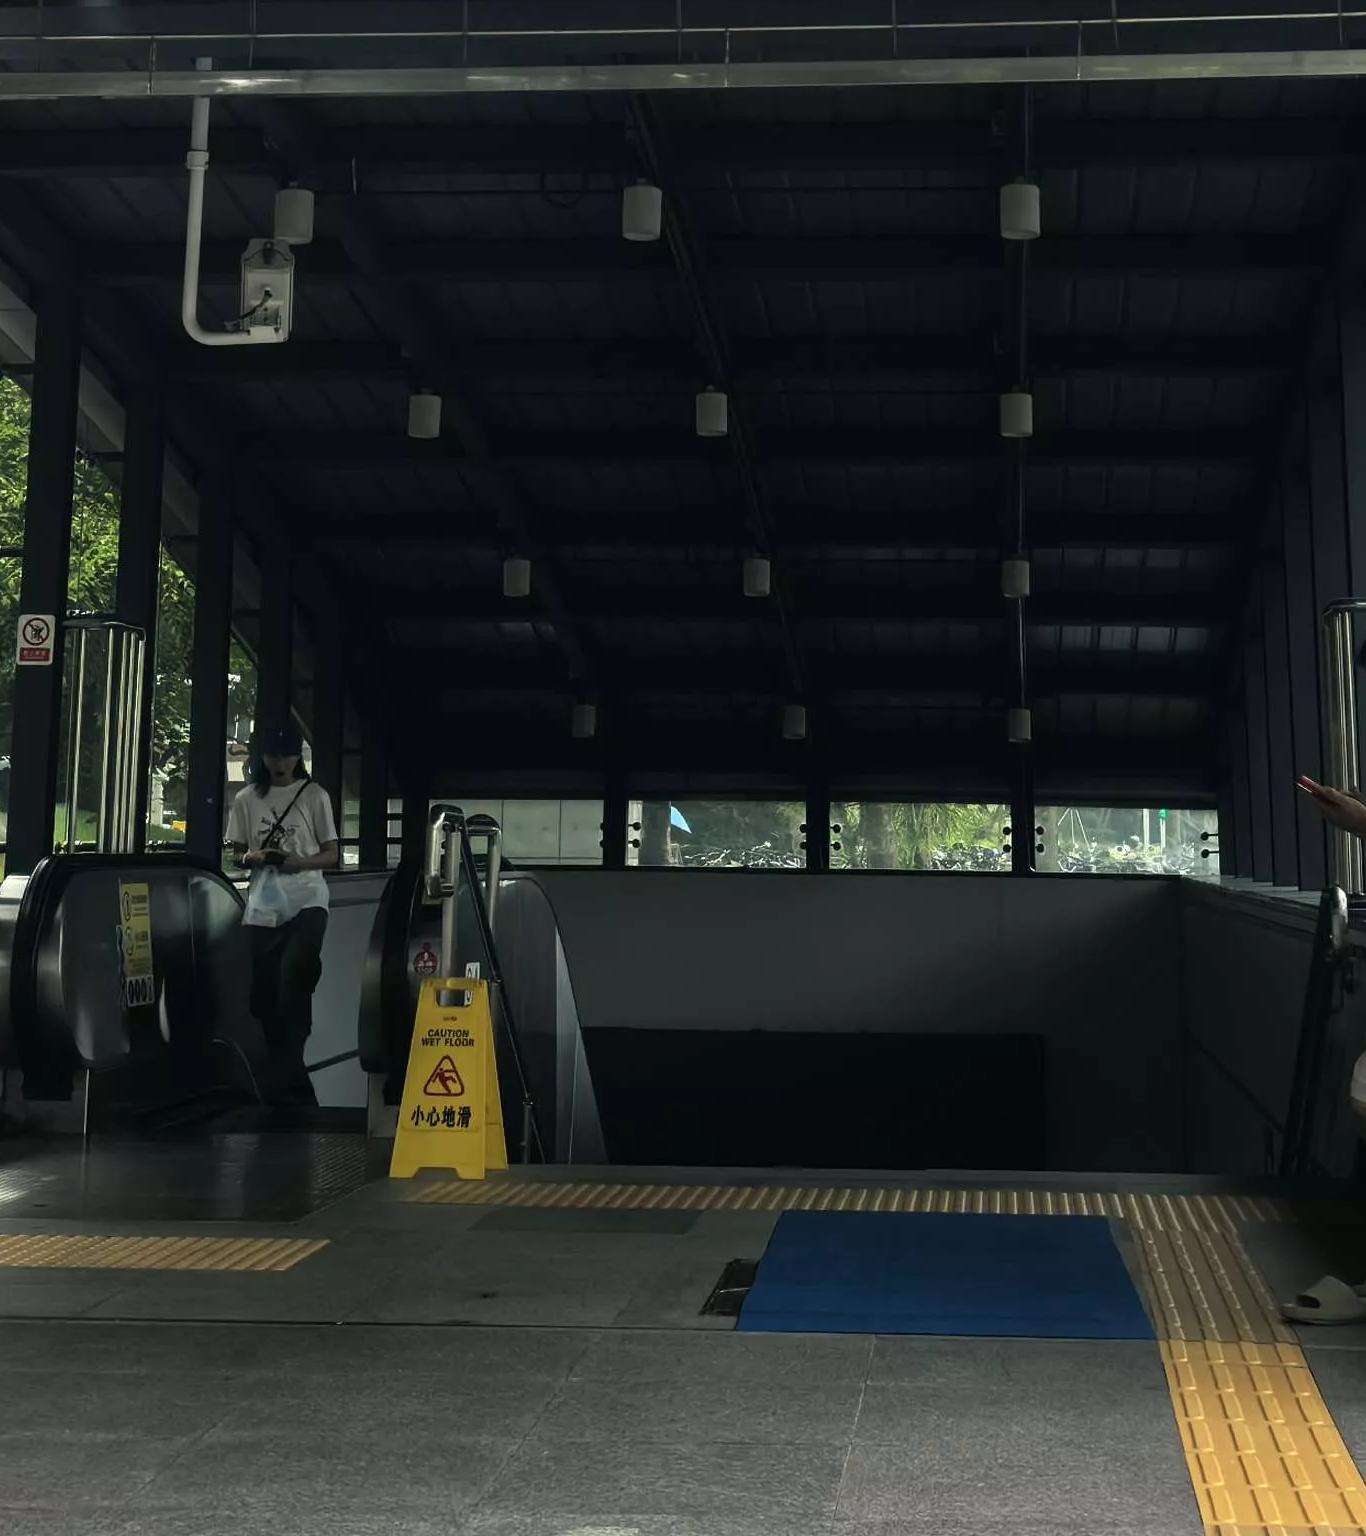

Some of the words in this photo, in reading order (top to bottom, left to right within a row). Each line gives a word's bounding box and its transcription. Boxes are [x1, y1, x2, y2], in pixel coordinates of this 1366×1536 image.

[427, 1028, 470, 1038] CAUTION
[422, 1037, 441, 1047] WET
[444, 1037, 475, 1047] FLOOR
[411, 1105, 471, 1128] 小心地滑
